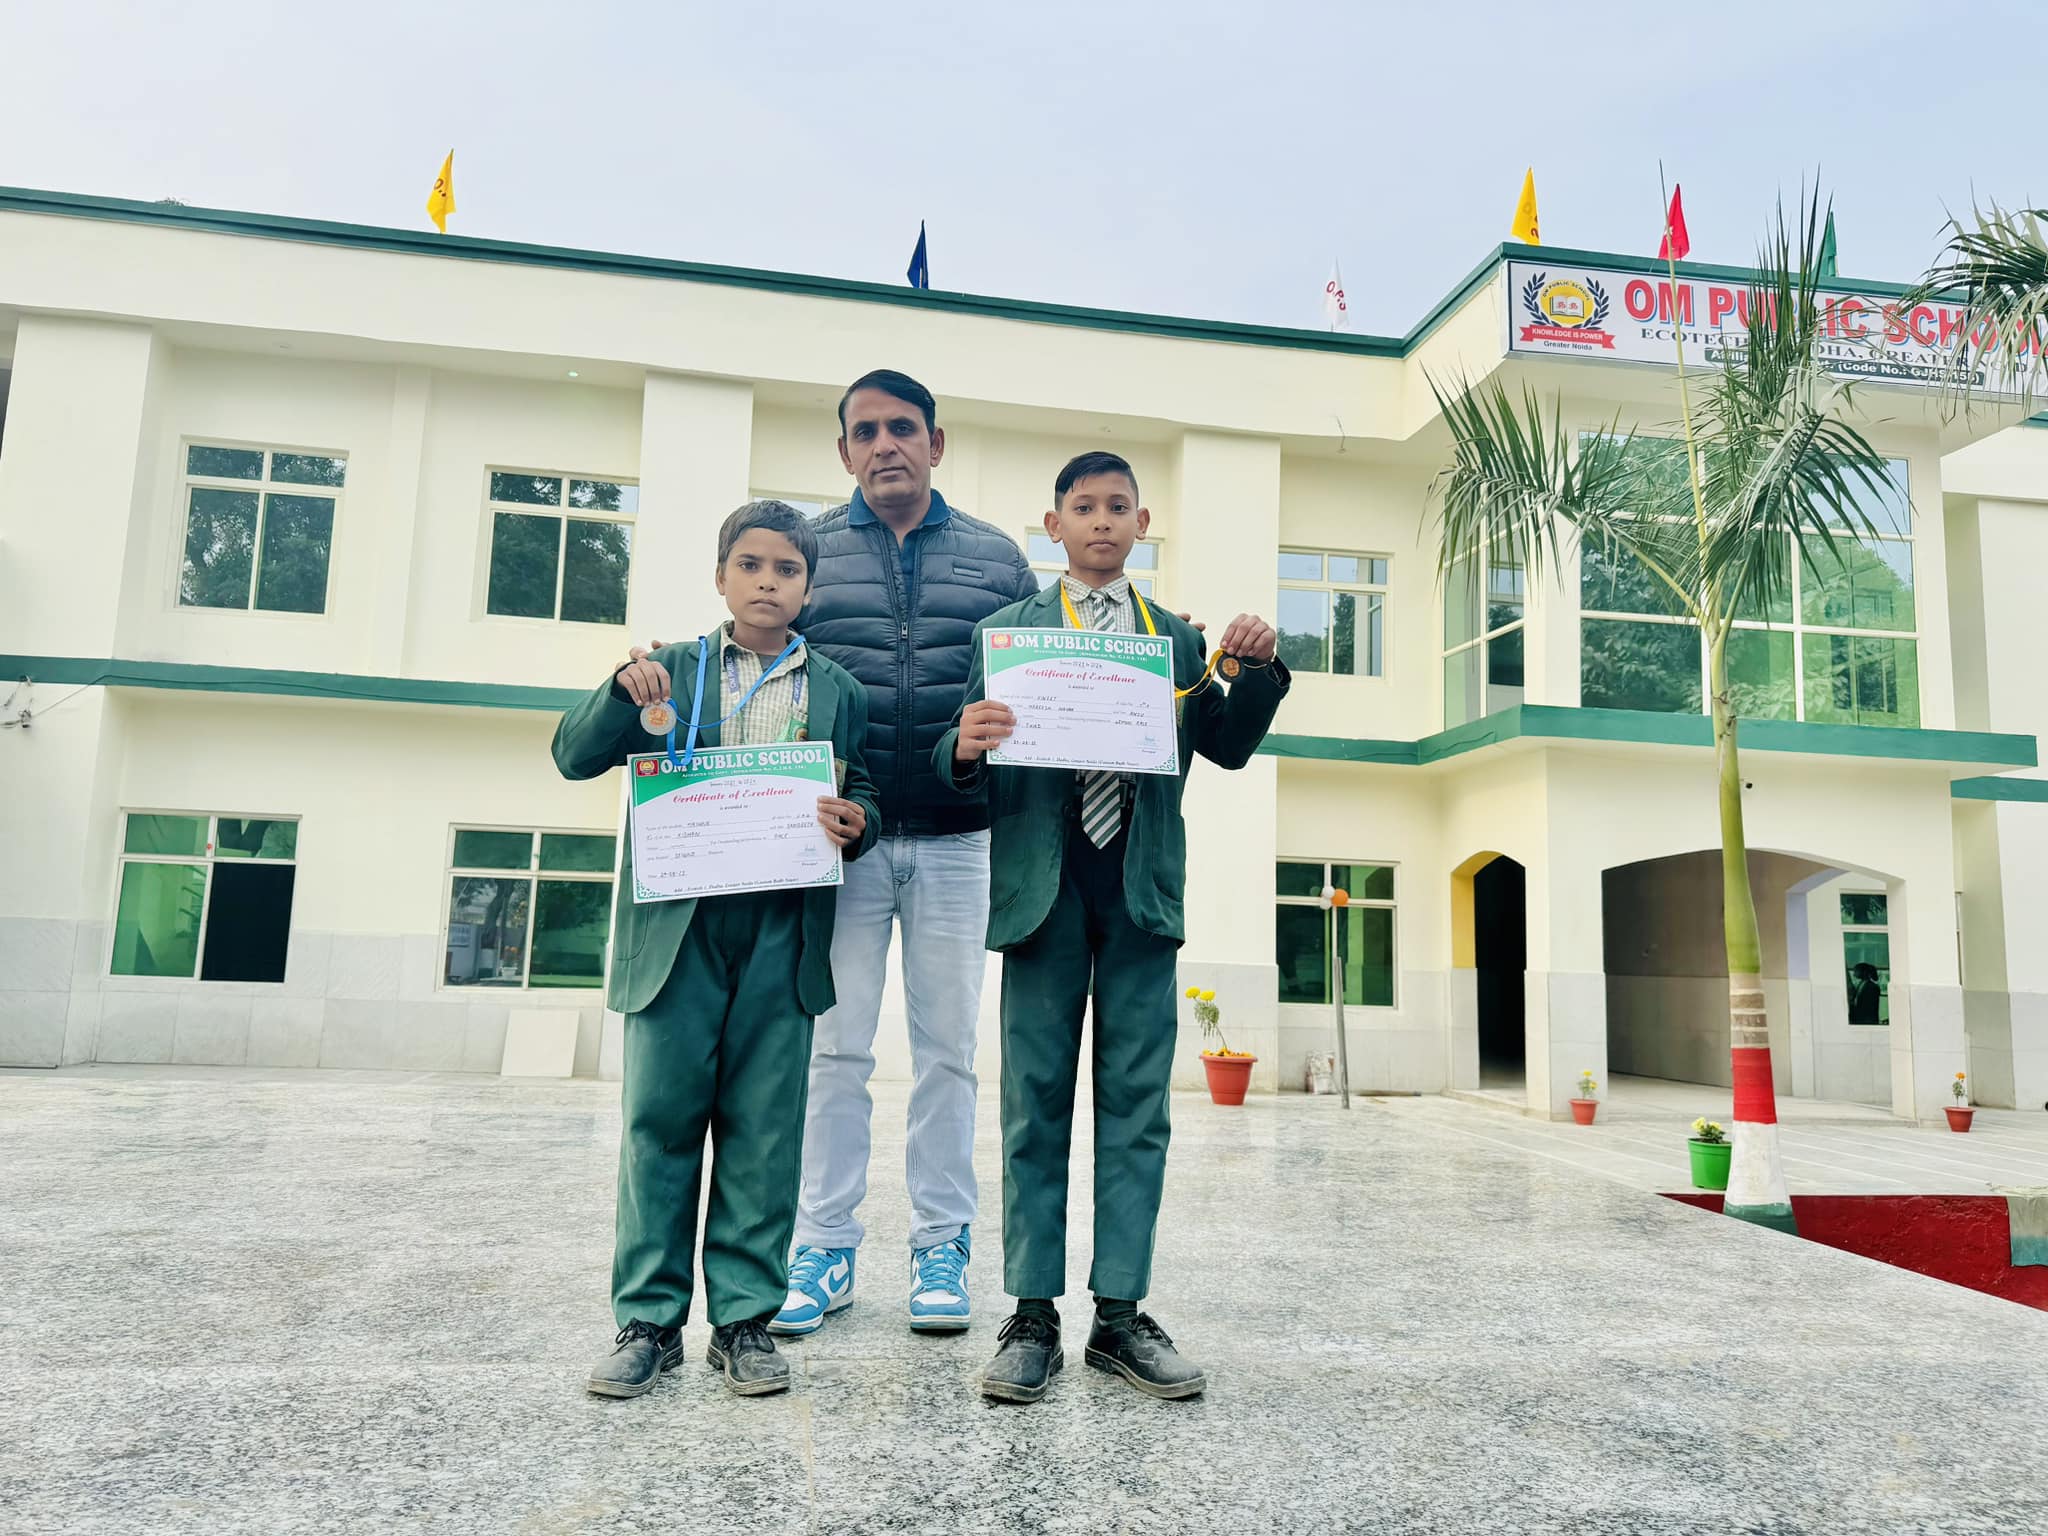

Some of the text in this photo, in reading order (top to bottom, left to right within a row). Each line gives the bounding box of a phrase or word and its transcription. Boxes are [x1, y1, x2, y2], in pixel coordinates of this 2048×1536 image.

[1624, 279, 1695, 326] OM
[1708, 286, 1868, 342] PUIC
[1531, 328, 1572, 338] KNOWLEDGE
[1580, 331, 1603, 340] POWER
[1543, 340, 1592, 350] Greater Noida
[1838, 359, 1877, 373] (Code
[1013, 634, 1039, 648] OM
[1043, 634, 1100, 651] PUBLIC
[1104, 638, 1166, 657] SCHOOL
[1025, 668, 1136, 683] Certificate of Excellence
[692, 753, 754, 771] PUBLIC
[758, 749, 826, 766] SCHOOL
[673, 788, 793, 804] Certificate of Excellence
